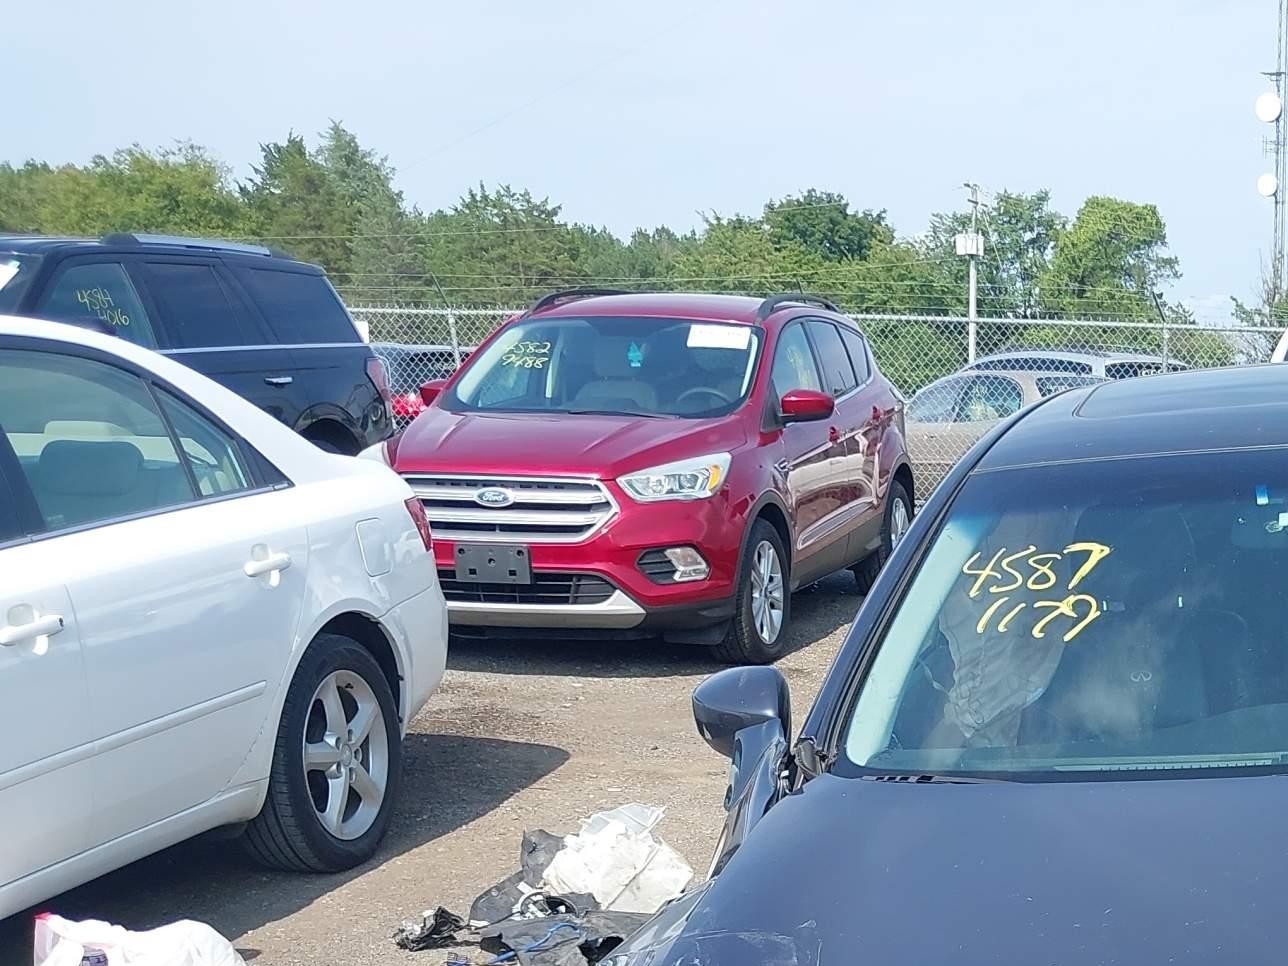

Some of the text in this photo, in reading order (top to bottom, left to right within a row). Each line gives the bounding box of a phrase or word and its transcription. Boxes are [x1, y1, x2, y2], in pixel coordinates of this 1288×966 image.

[482, 491, 505, 502] Ford
[962, 542, 1113, 598] 4587
[976, 594, 1101, 642] 1179
